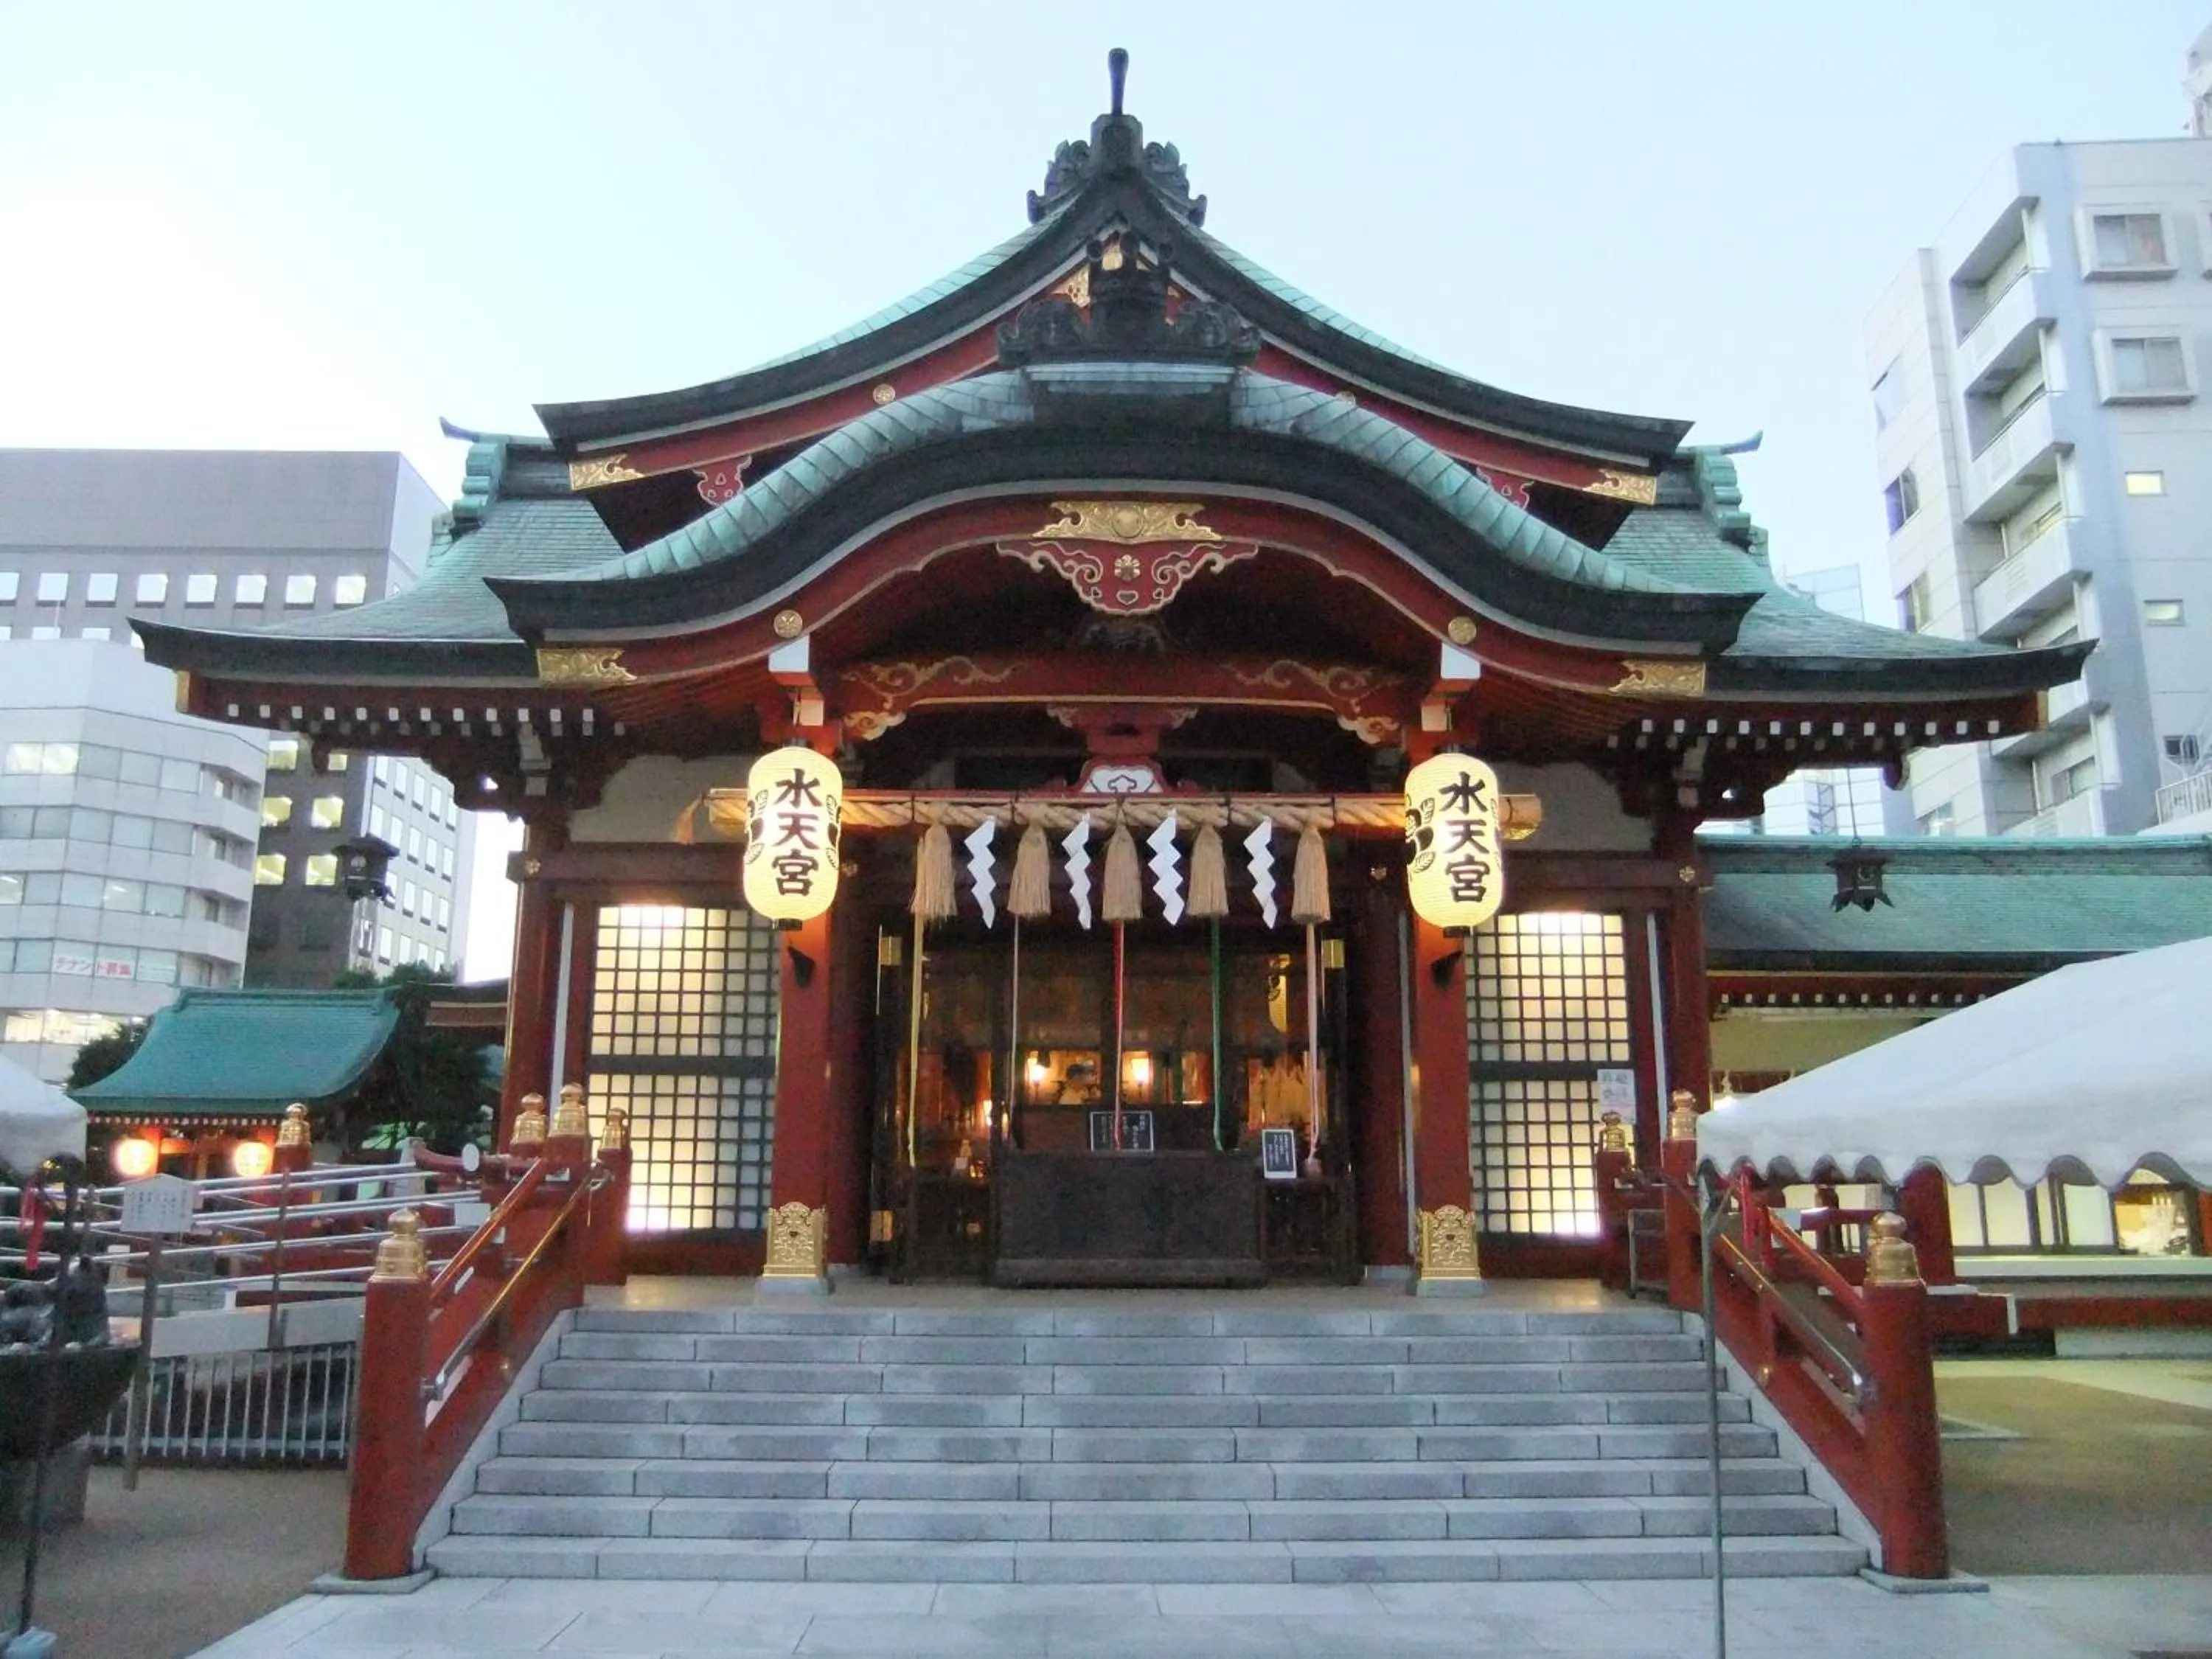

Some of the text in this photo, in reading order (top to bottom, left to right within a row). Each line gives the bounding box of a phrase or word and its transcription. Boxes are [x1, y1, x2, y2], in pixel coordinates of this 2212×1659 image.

[773, 768, 823, 897] 水天宮
[1439, 771, 1490, 903] 水天宮
